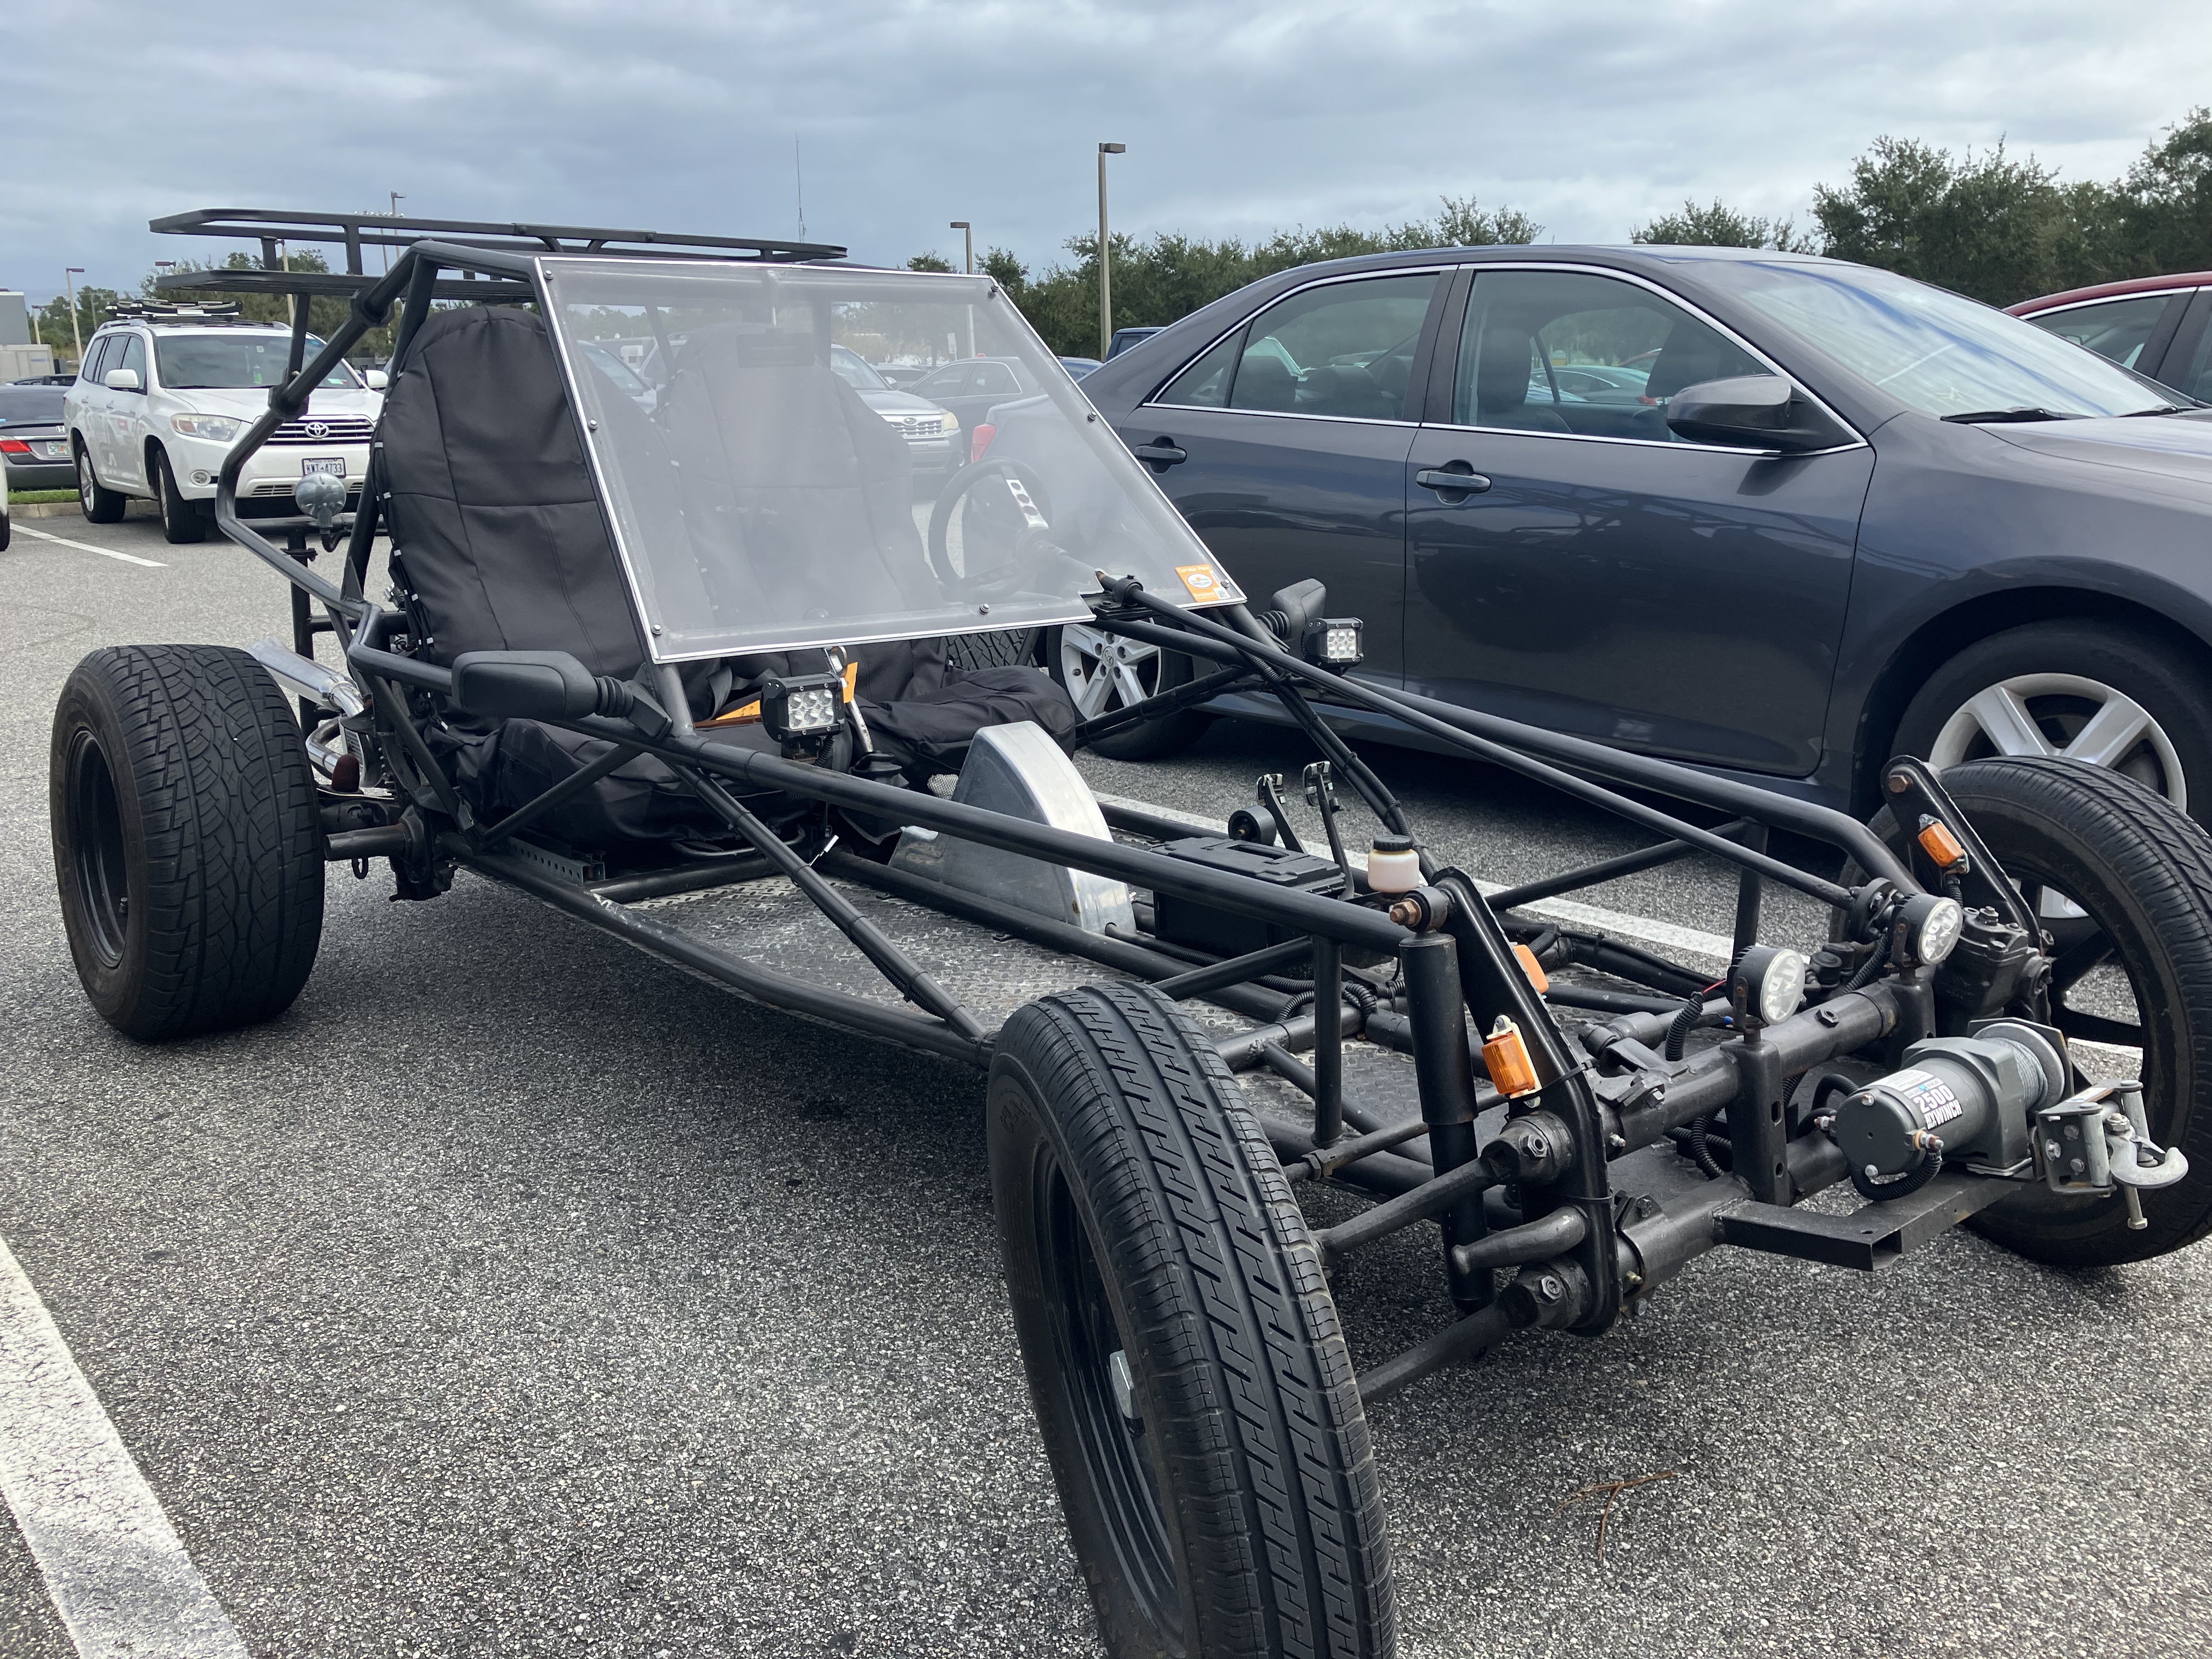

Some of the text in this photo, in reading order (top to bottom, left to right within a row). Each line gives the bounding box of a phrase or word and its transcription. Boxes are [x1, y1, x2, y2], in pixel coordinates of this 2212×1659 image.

[325, 463, 342, 473] 4733
[1913, 1085, 1955, 1114] 2500
[1932, 1099, 1962, 1125] WINCH
